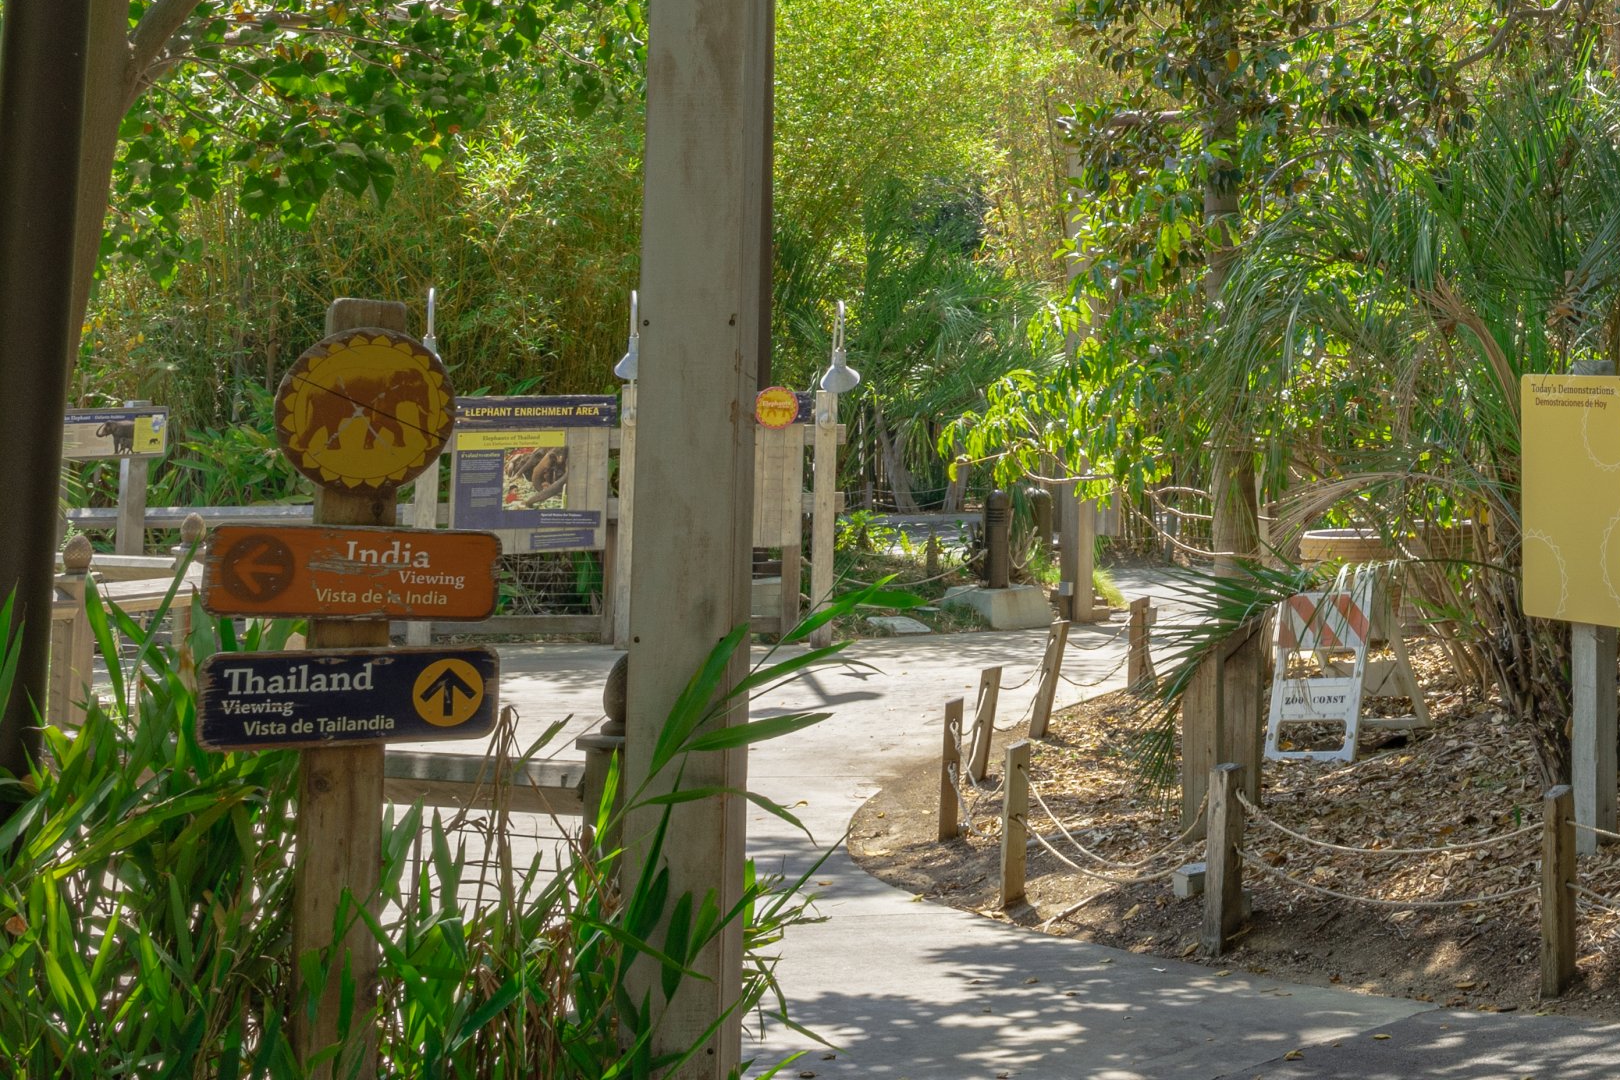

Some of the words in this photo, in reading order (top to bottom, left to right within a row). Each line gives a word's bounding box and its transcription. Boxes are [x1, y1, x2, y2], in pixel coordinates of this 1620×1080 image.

[1531, 383, 1557, 396] Today's
[1558, 384, 1615, 396] Demonstrations
[465, 407, 511, 417] ELEPHANT
[514, 406, 574, 417] ENRICHMENT
[575, 406, 600, 416] AREA
[1535, 397, 1584, 408] Demostraciones
[1585, 399, 1593, 408] de
[1594, 400, 1607, 410] Hoy
[346, 540, 430, 568] India
[399, 570, 465, 589] Viewing
[316, 588, 357, 603] Vista
[361, 589, 383, 604] de
[406, 590, 448, 605] India
[223, 662, 374, 695] Thailand
[221, 699, 294, 716] Viewing
[1285, 696, 1304, 705] ZOO
[1312, 695, 1346, 705] CONST
[243, 721, 287, 736] Vista
[291, 719, 314, 734] de
[317, 715, 395, 733] Tailandia
